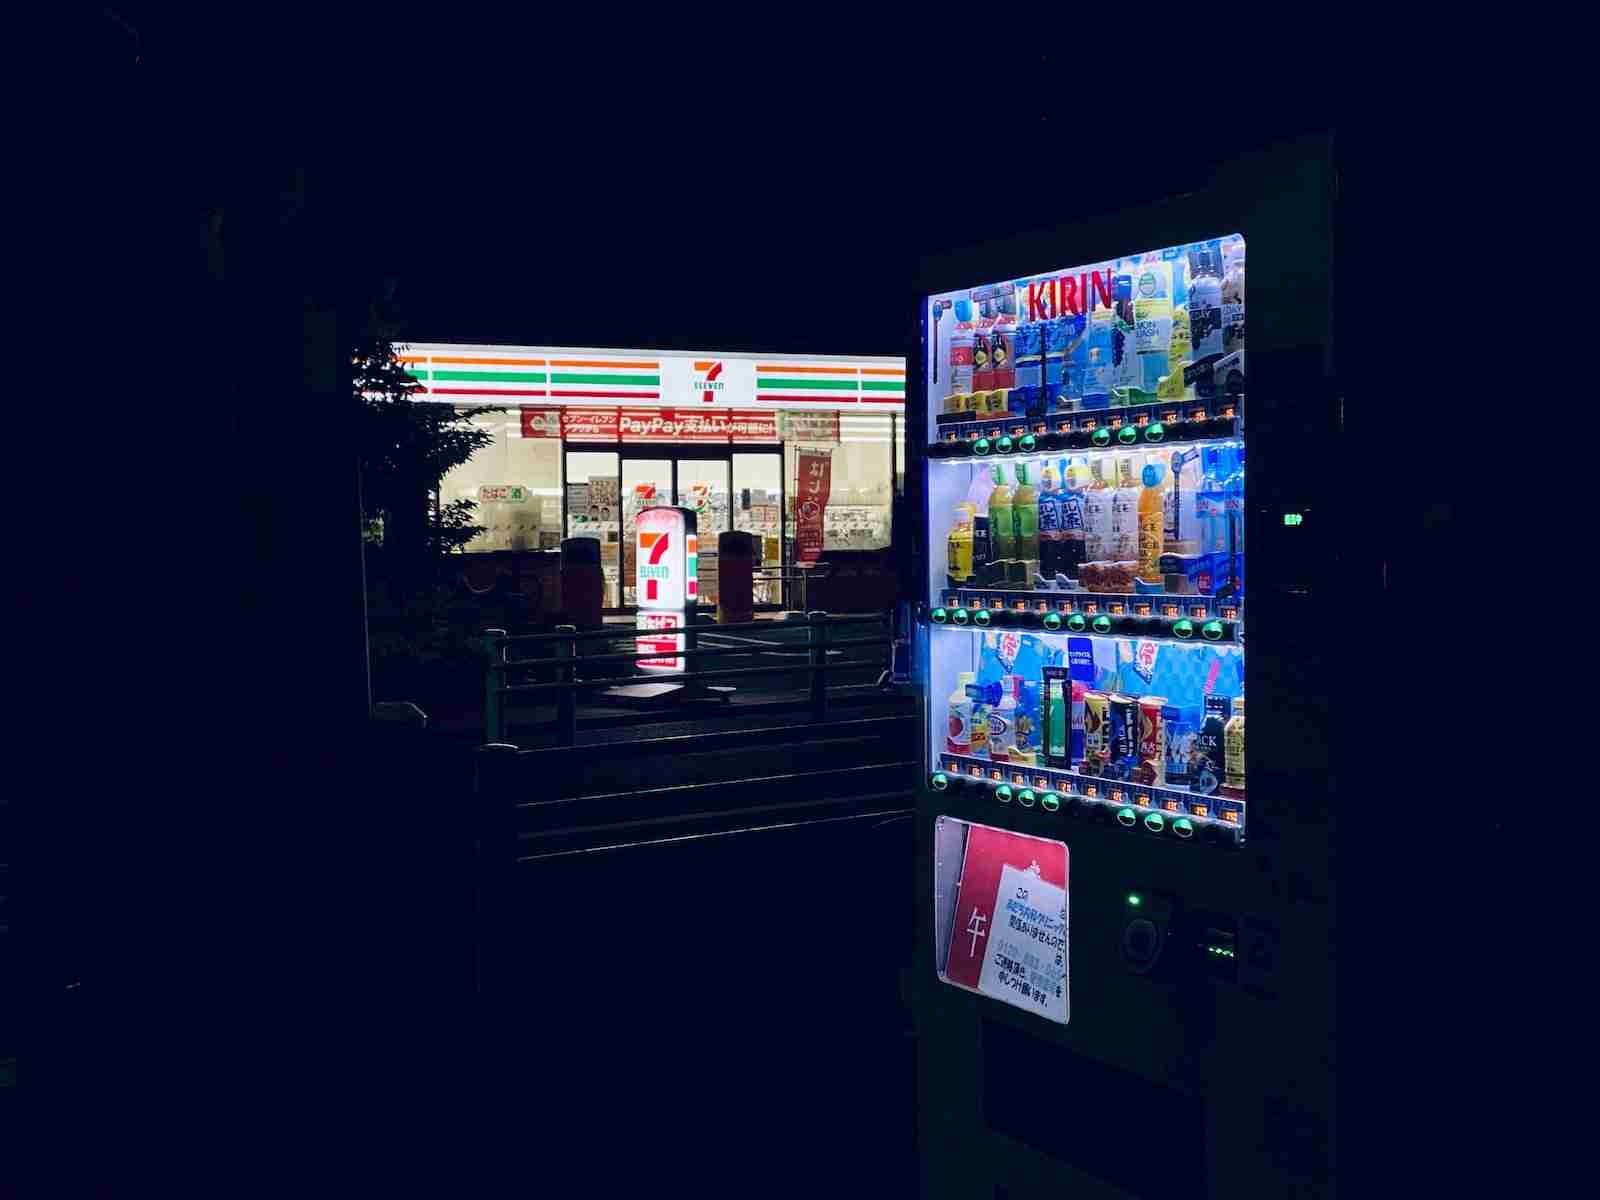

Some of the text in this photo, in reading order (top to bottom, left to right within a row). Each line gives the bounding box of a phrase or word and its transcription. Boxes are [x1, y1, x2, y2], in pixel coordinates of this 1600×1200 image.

[1028, 267, 1112, 322] KIRIN
[693, 361, 723, 403] 7
[640, 533, 669, 601] 7
[966, 907, 988, 958] 午
